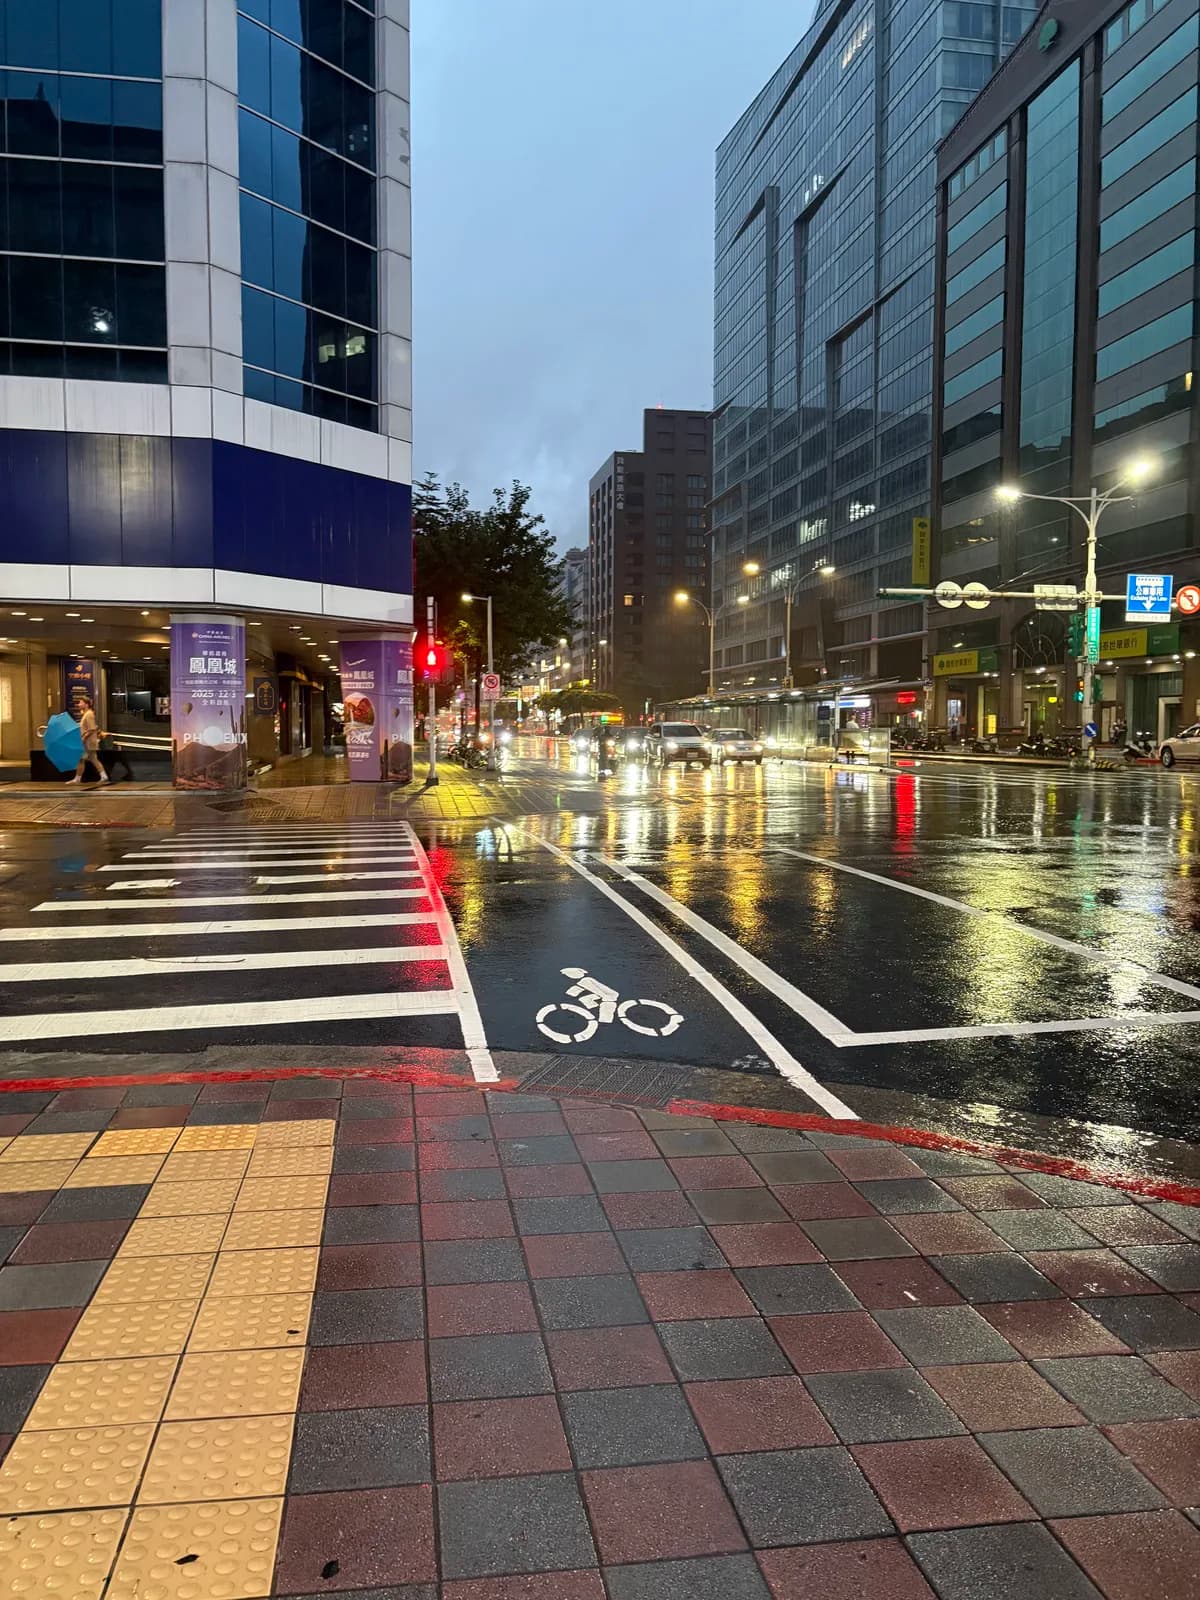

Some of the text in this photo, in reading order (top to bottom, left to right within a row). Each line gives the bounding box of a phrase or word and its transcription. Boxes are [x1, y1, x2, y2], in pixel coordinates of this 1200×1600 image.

[1136, 587, 1163, 596] 公車專用
[1101, 637, 1138, 651] 泰世華銀行
[190, 657, 237, 675] 鳳凰城
